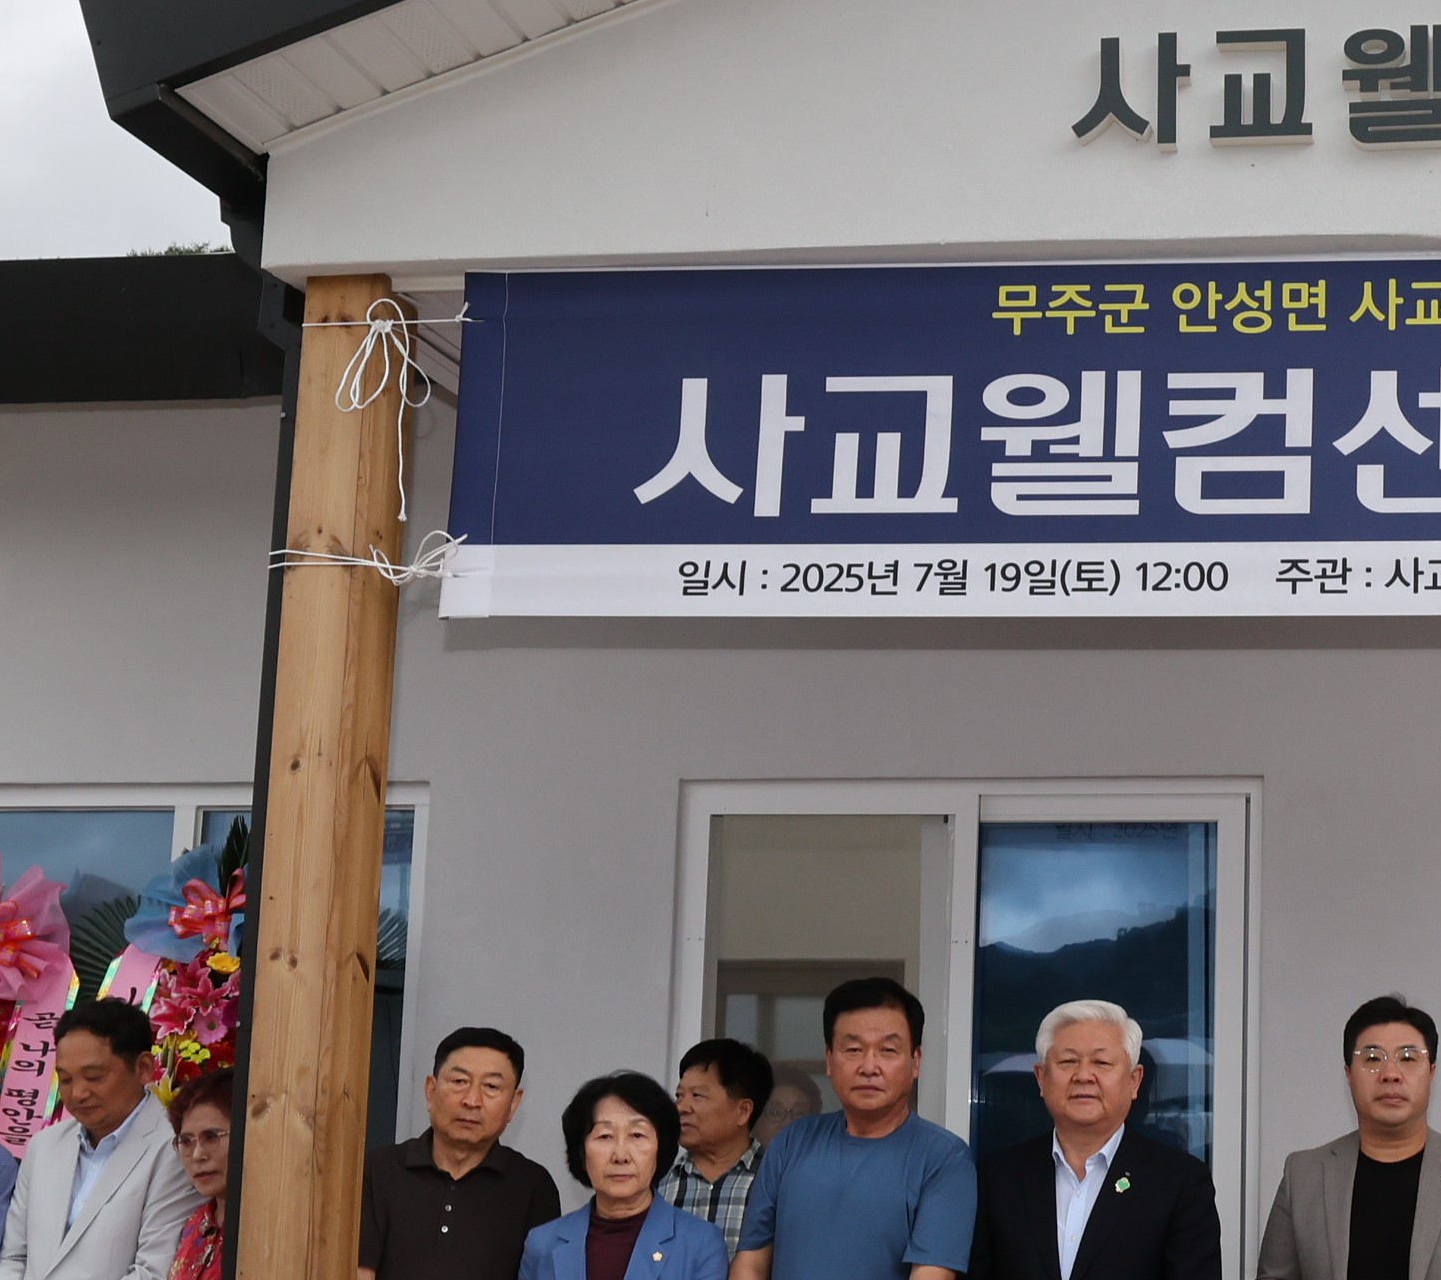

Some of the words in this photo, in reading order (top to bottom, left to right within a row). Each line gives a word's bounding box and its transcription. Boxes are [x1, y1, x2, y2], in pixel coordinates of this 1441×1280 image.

[991, 283, 1150, 336] 무주군
[1172, 279, 1327, 334] 안성면
[678, 560, 747, 596] 일시
[780, 560, 899, 596] 2025년
[913, 559, 968, 596] 7월
[984, 559, 1121, 597] 19일(토)
[1136, 561, 1229, 592] 12:00
[1275, 557, 1353, 595] 주관
